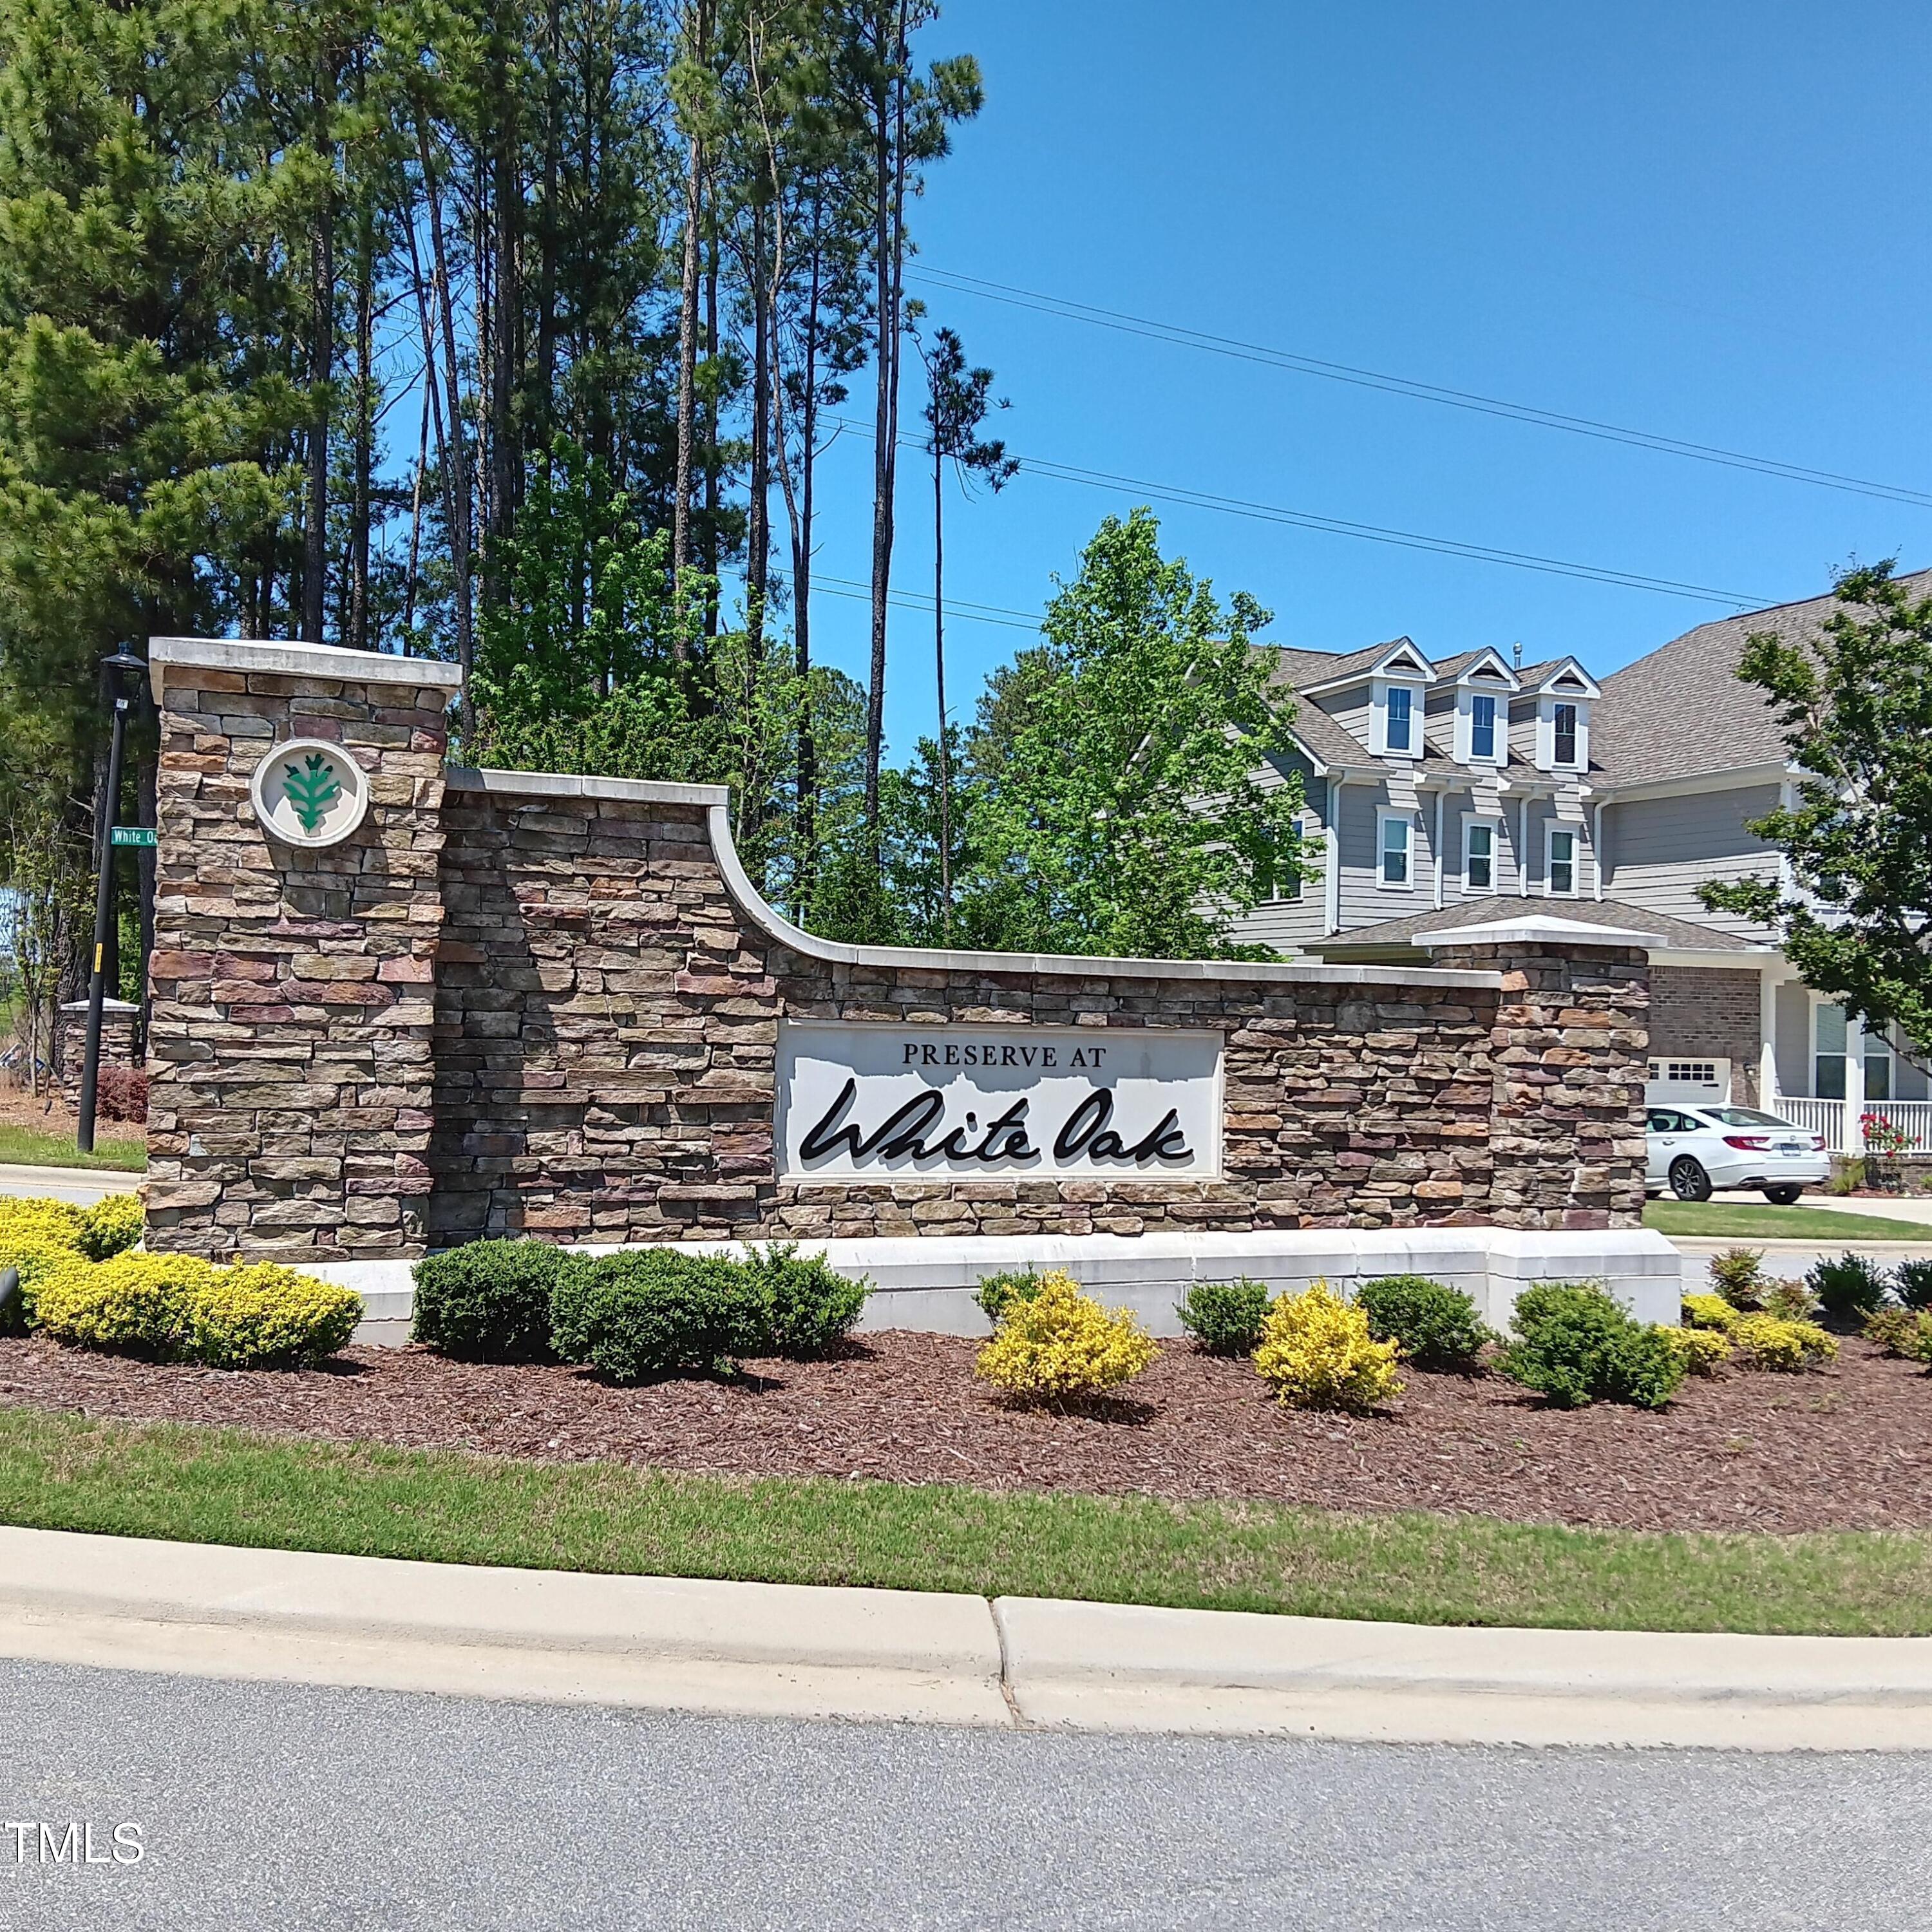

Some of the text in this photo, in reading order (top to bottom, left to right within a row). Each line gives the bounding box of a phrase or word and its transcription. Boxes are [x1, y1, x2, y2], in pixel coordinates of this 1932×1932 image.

[115, 830, 141, 844] White
[902, 1043, 1106, 1068] PRESERVE AT
[799, 1077, 1194, 1162] White Oak
